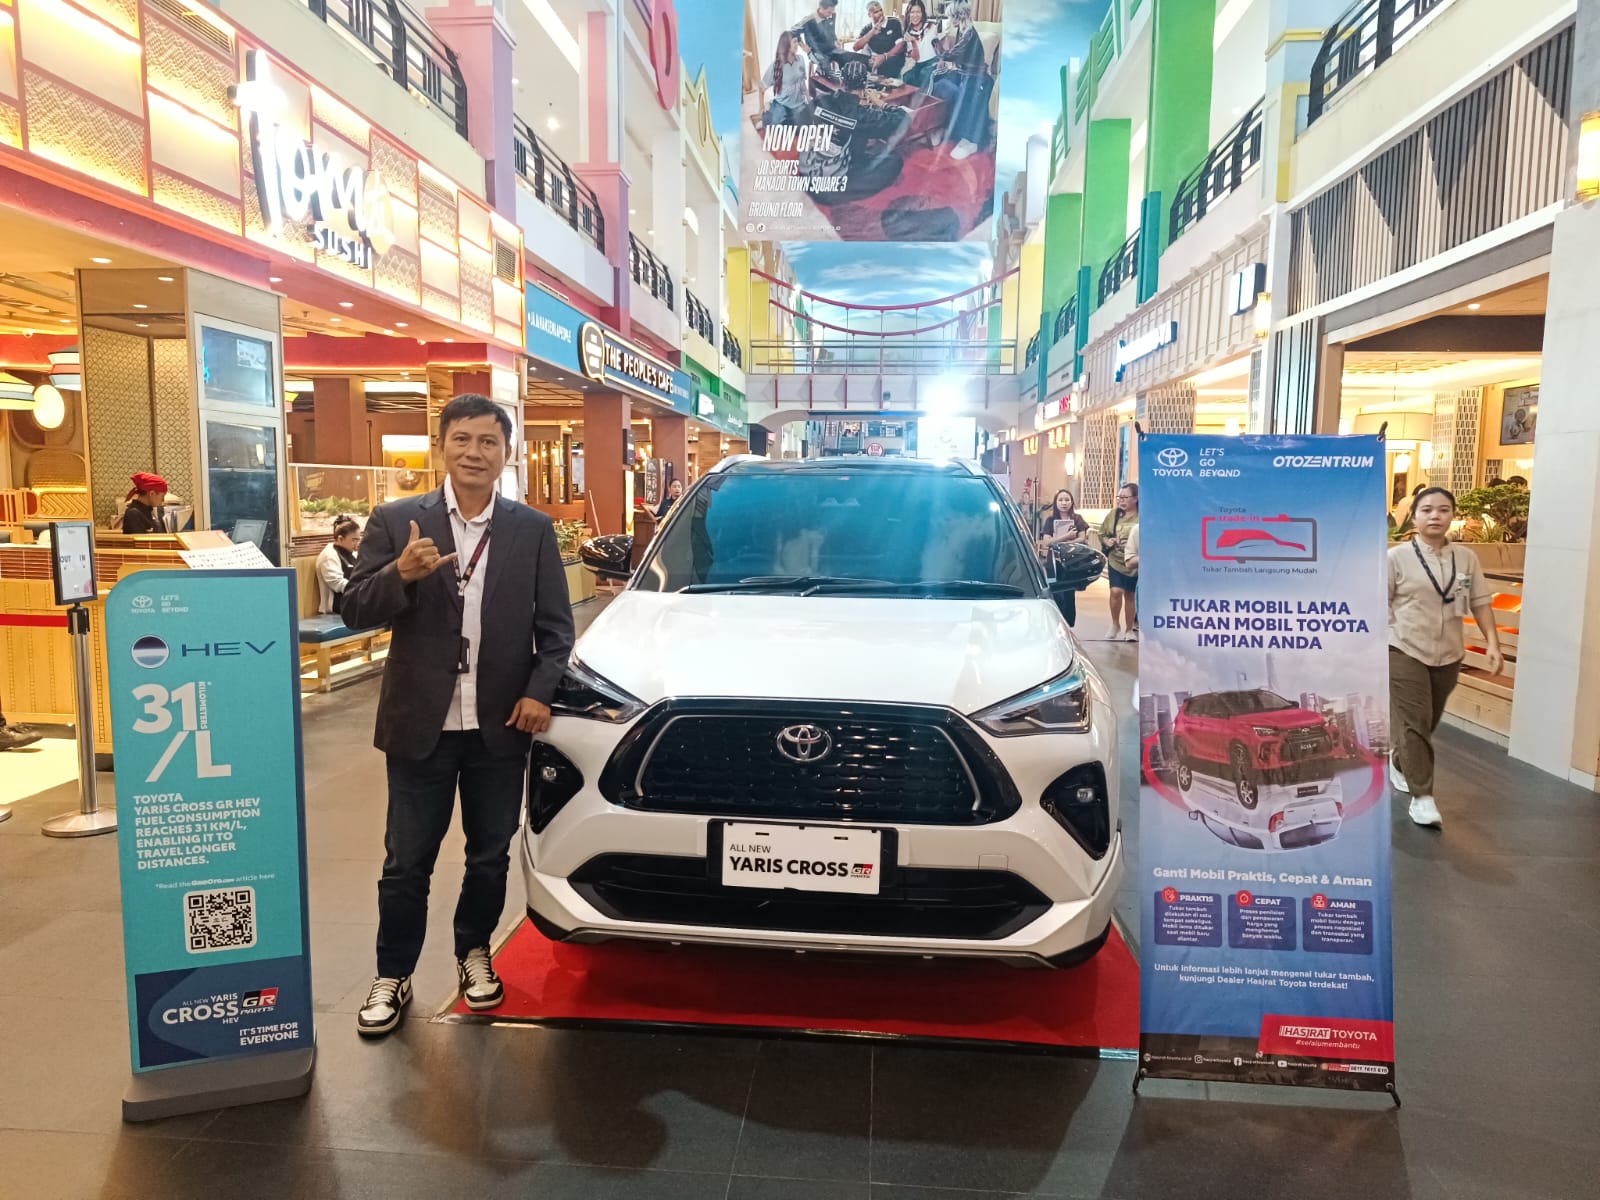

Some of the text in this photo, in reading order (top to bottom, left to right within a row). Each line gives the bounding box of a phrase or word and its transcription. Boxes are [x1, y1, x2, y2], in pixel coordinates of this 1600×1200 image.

[762, 124, 834, 152] NOW OPEN
[757, 160, 800, 176] JD SPORTS
[753, 176, 848, 194] MANADO TOWN SQUARE 3
[748, 202, 803, 217] GROUND FLOOR
[312, 221, 373, 269] SUSHI
[605, 342, 622, 373] THE
[1200, 448, 1224, 456] LET'S
[1200, 459, 1215, 467] GO
[1273, 456, 1374, 469] OTOZENTRUM
[1152, 469, 1193, 477] TOYOTA
[1200, 469, 1240, 478] BEYOND
[1254, 566, 1290, 575] Langsung
[1169, 598, 1351, 616] TUKAR MOBIL LAMA
[1153, 616, 1370, 634] DENGAN MOBIL TOYOTA
[182, 641, 276, 657] HEV
[1197, 633, 1323, 650] IMPIAN ANDA
[132, 682, 198, 734] 31
[133, 793, 184, 805] TOYOTA
[134, 798, 260, 816] YARIS CROSS GR HEV
[136, 808, 261, 826] FUEL CONSUMPTION
[136, 820, 248, 838] REACHES 31 KM/L,
[136, 832, 233, 849] ENABLING IT TO
[136, 842, 237, 860] TRAVEL LONGER
[730, 844, 772, 854] ALL NEW
[138, 855, 210, 870] DISTANCES.
[730, 856, 783, 874] YARIS
[786, 859, 848, 878] CROSS
[259, 873, 276, 881] here
[1153, 867, 1373, 888] Ganti Mobil Praktis, Cepat & Aman
[1180, 895, 1214, 903] PRAKTIS
[1255, 898, 1281, 906] CEPAT
[1330, 902, 1356, 910] AMAN
[1154, 963, 1179, 972] Untuk
[1180, 964, 1220, 974] informasi
[1222, 966, 1243, 974] lebih
[1244, 967, 1269, 977] lanjut
[1271, 969, 1312, 980] mengenai
[1314, 970, 1336, 980] tukar
[1179, 974, 1348, 990] kunjungi Dealer Hasjrat Toyota terdekat!
[210, 992, 238, 1002] YARIS
[242, 993, 277, 1008] GR
[162, 1001, 240, 1025] CROSS
[240, 1006, 274, 1016] PARTS
[222, 1016, 240, 1026] HEV
[240, 1022, 298, 1036] IT'S TIME FOR
[240, 1030, 300, 1046] EVERYONE
[1332, 1030, 1378, 1042] TOYOTA
